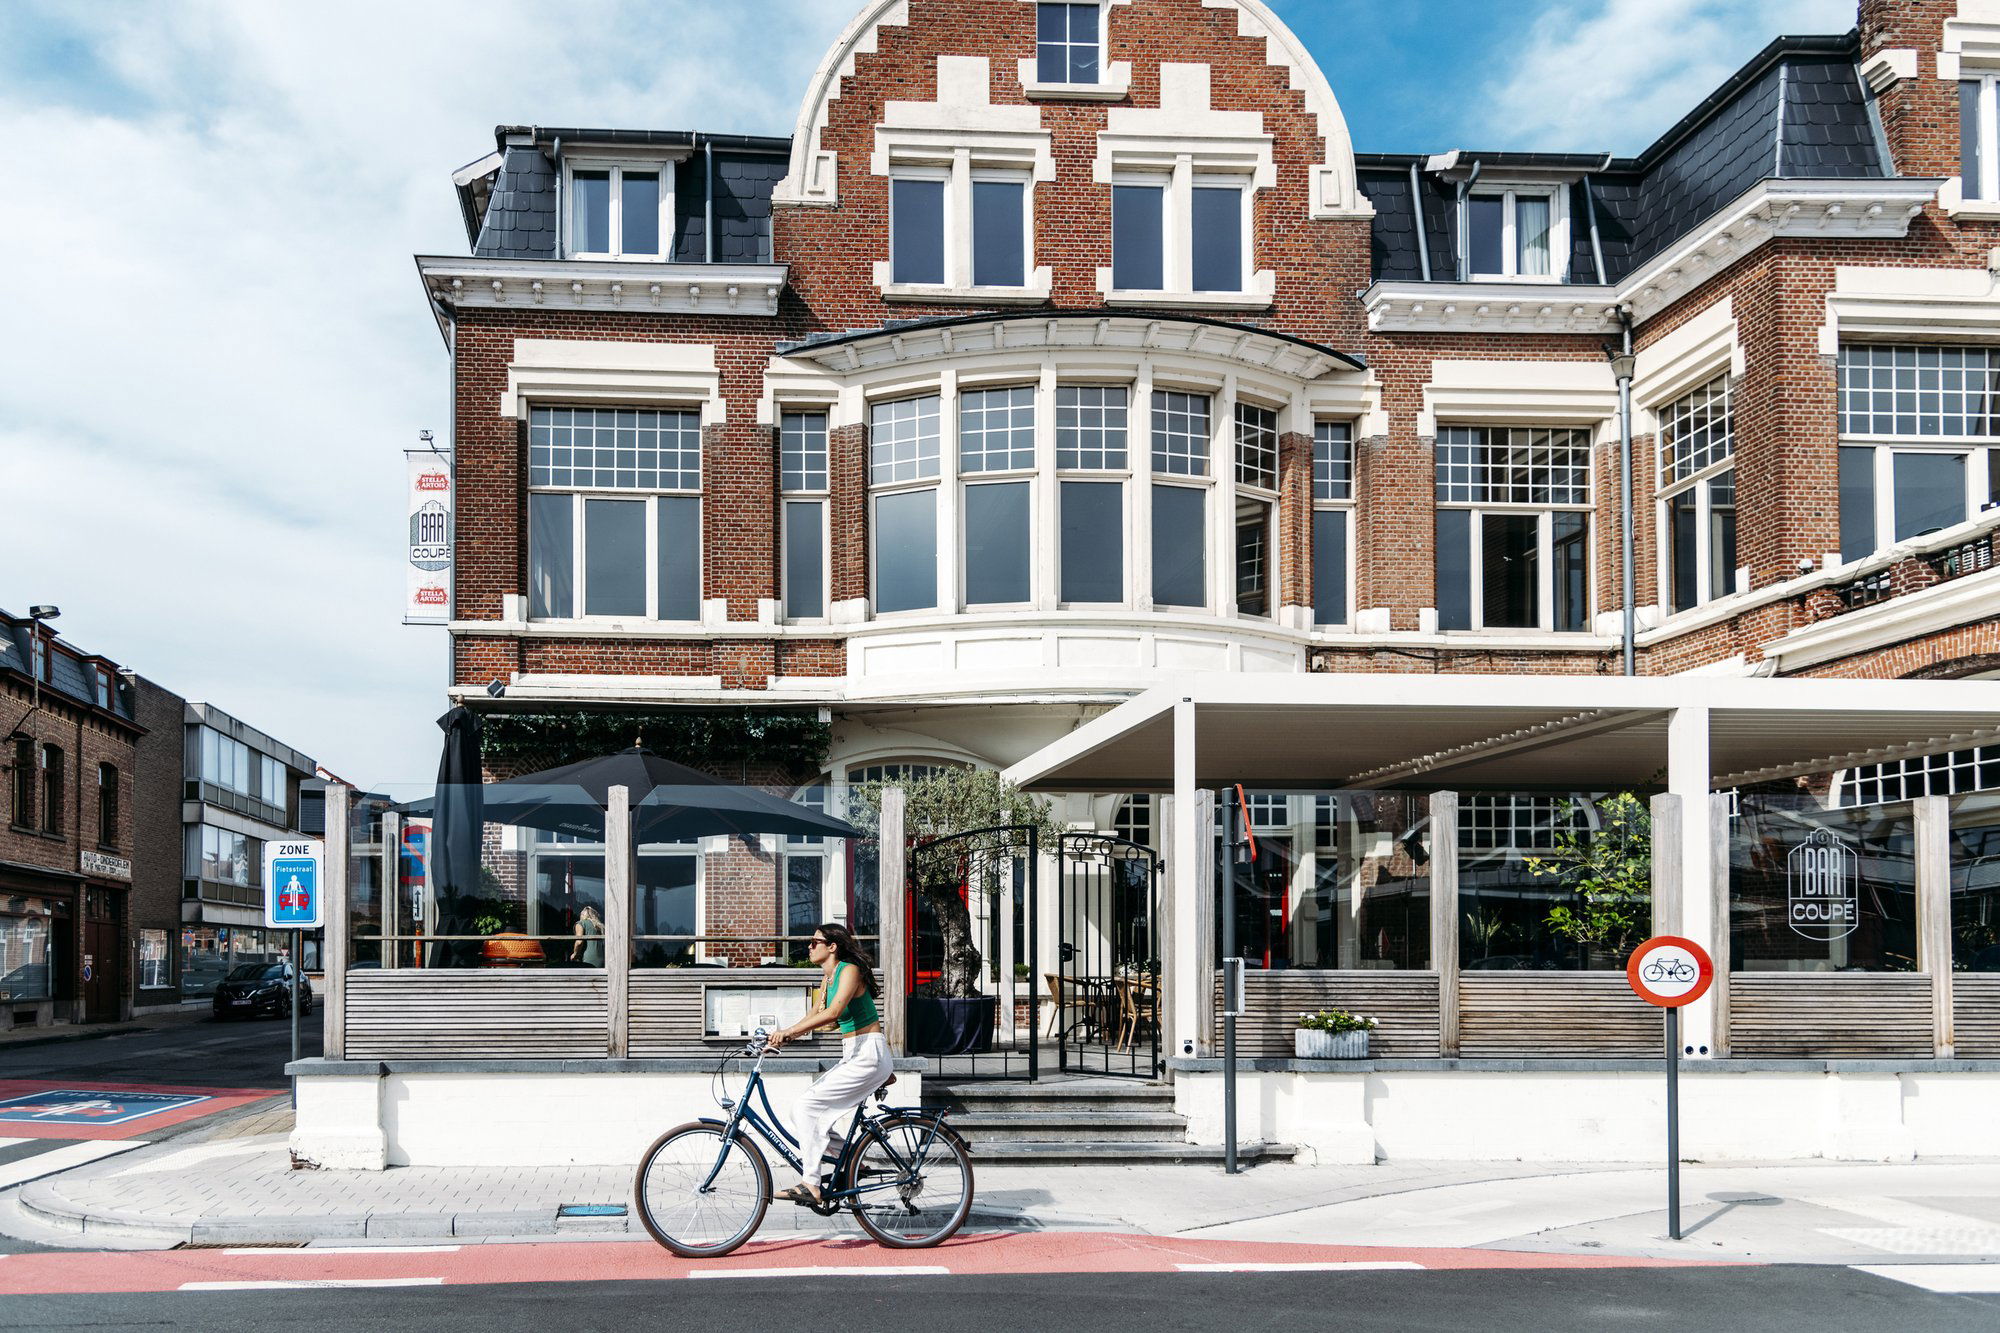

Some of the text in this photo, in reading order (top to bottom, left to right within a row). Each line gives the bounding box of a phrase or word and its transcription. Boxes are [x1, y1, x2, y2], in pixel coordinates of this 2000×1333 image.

[421, 513, 444, 542] BAR
[279, 845, 310, 855] ZONE
[1805, 848, 1841, 895] BAR
[1793, 898, 1855, 920] COUPÉ
[767, 1130, 798, 1162] minerva
